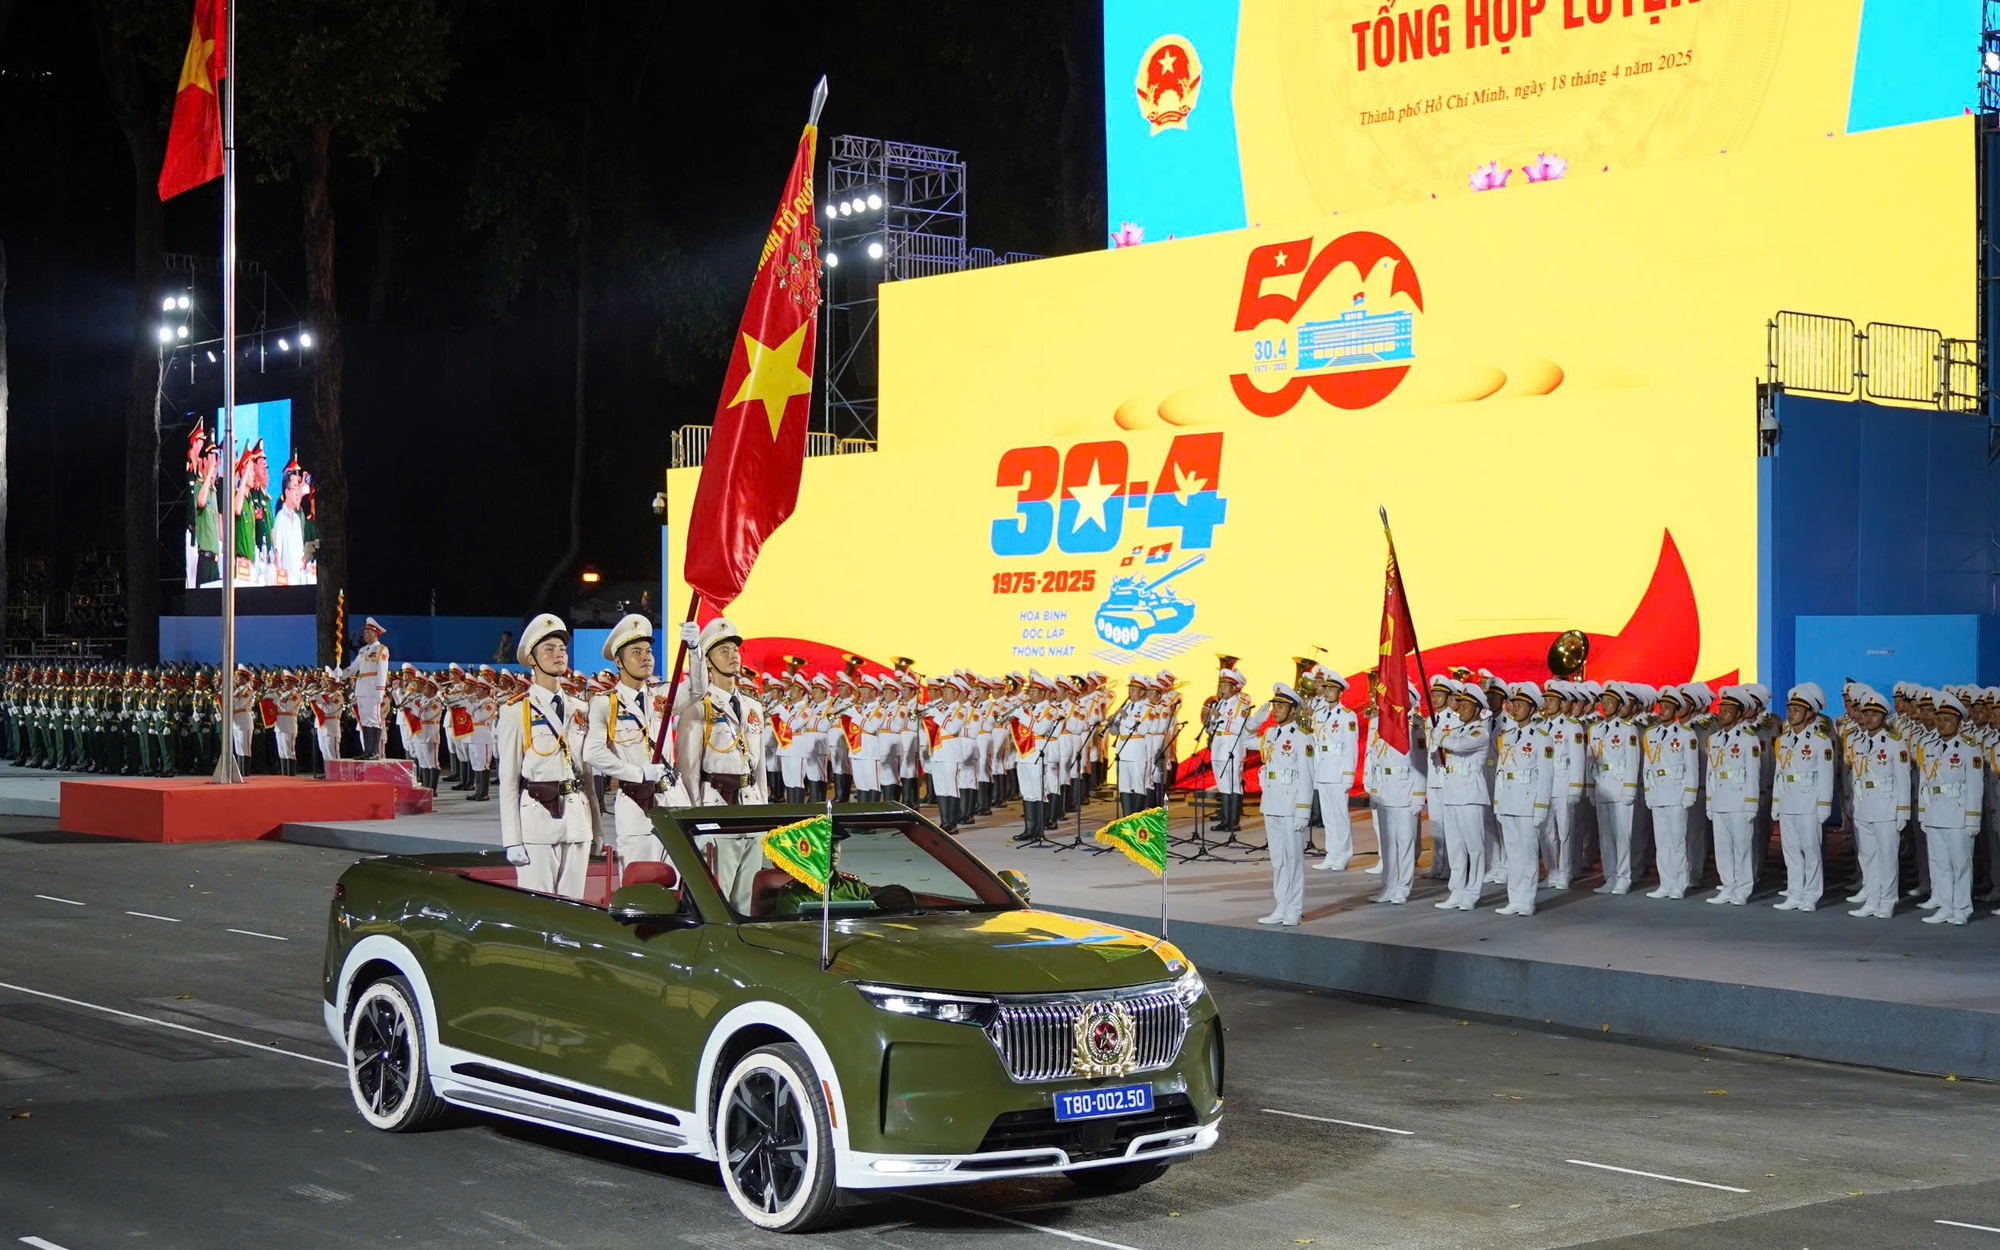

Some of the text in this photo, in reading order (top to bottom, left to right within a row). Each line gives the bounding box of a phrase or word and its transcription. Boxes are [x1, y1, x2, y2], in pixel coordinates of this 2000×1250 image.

[1360, 107, 1395, 126] Thành
[1398, 99, 1422, 122] phố
[1446, 92, 1470, 110] Chí
[1472, 86, 1509, 105] Minh,
[1514, 81, 1546, 100] ngày
[1551, 74, 1566, 91] 18
[1571, 69, 1607, 86] tháng
[1612, 64, 1620, 79] 4
[1625, 60, 1653, 77] năm
[1658, 50, 1693, 71] 2025
[777, 203, 799, 234] TỔ
[794, 171, 814, 215] QUỐ
[1229, 231, 1424, 418] 50
[1254, 338, 1288, 360] 30.4
[991, 432, 1227, 556] 30-4
[1063, 1089, 1145, 1115] T80-002.50
